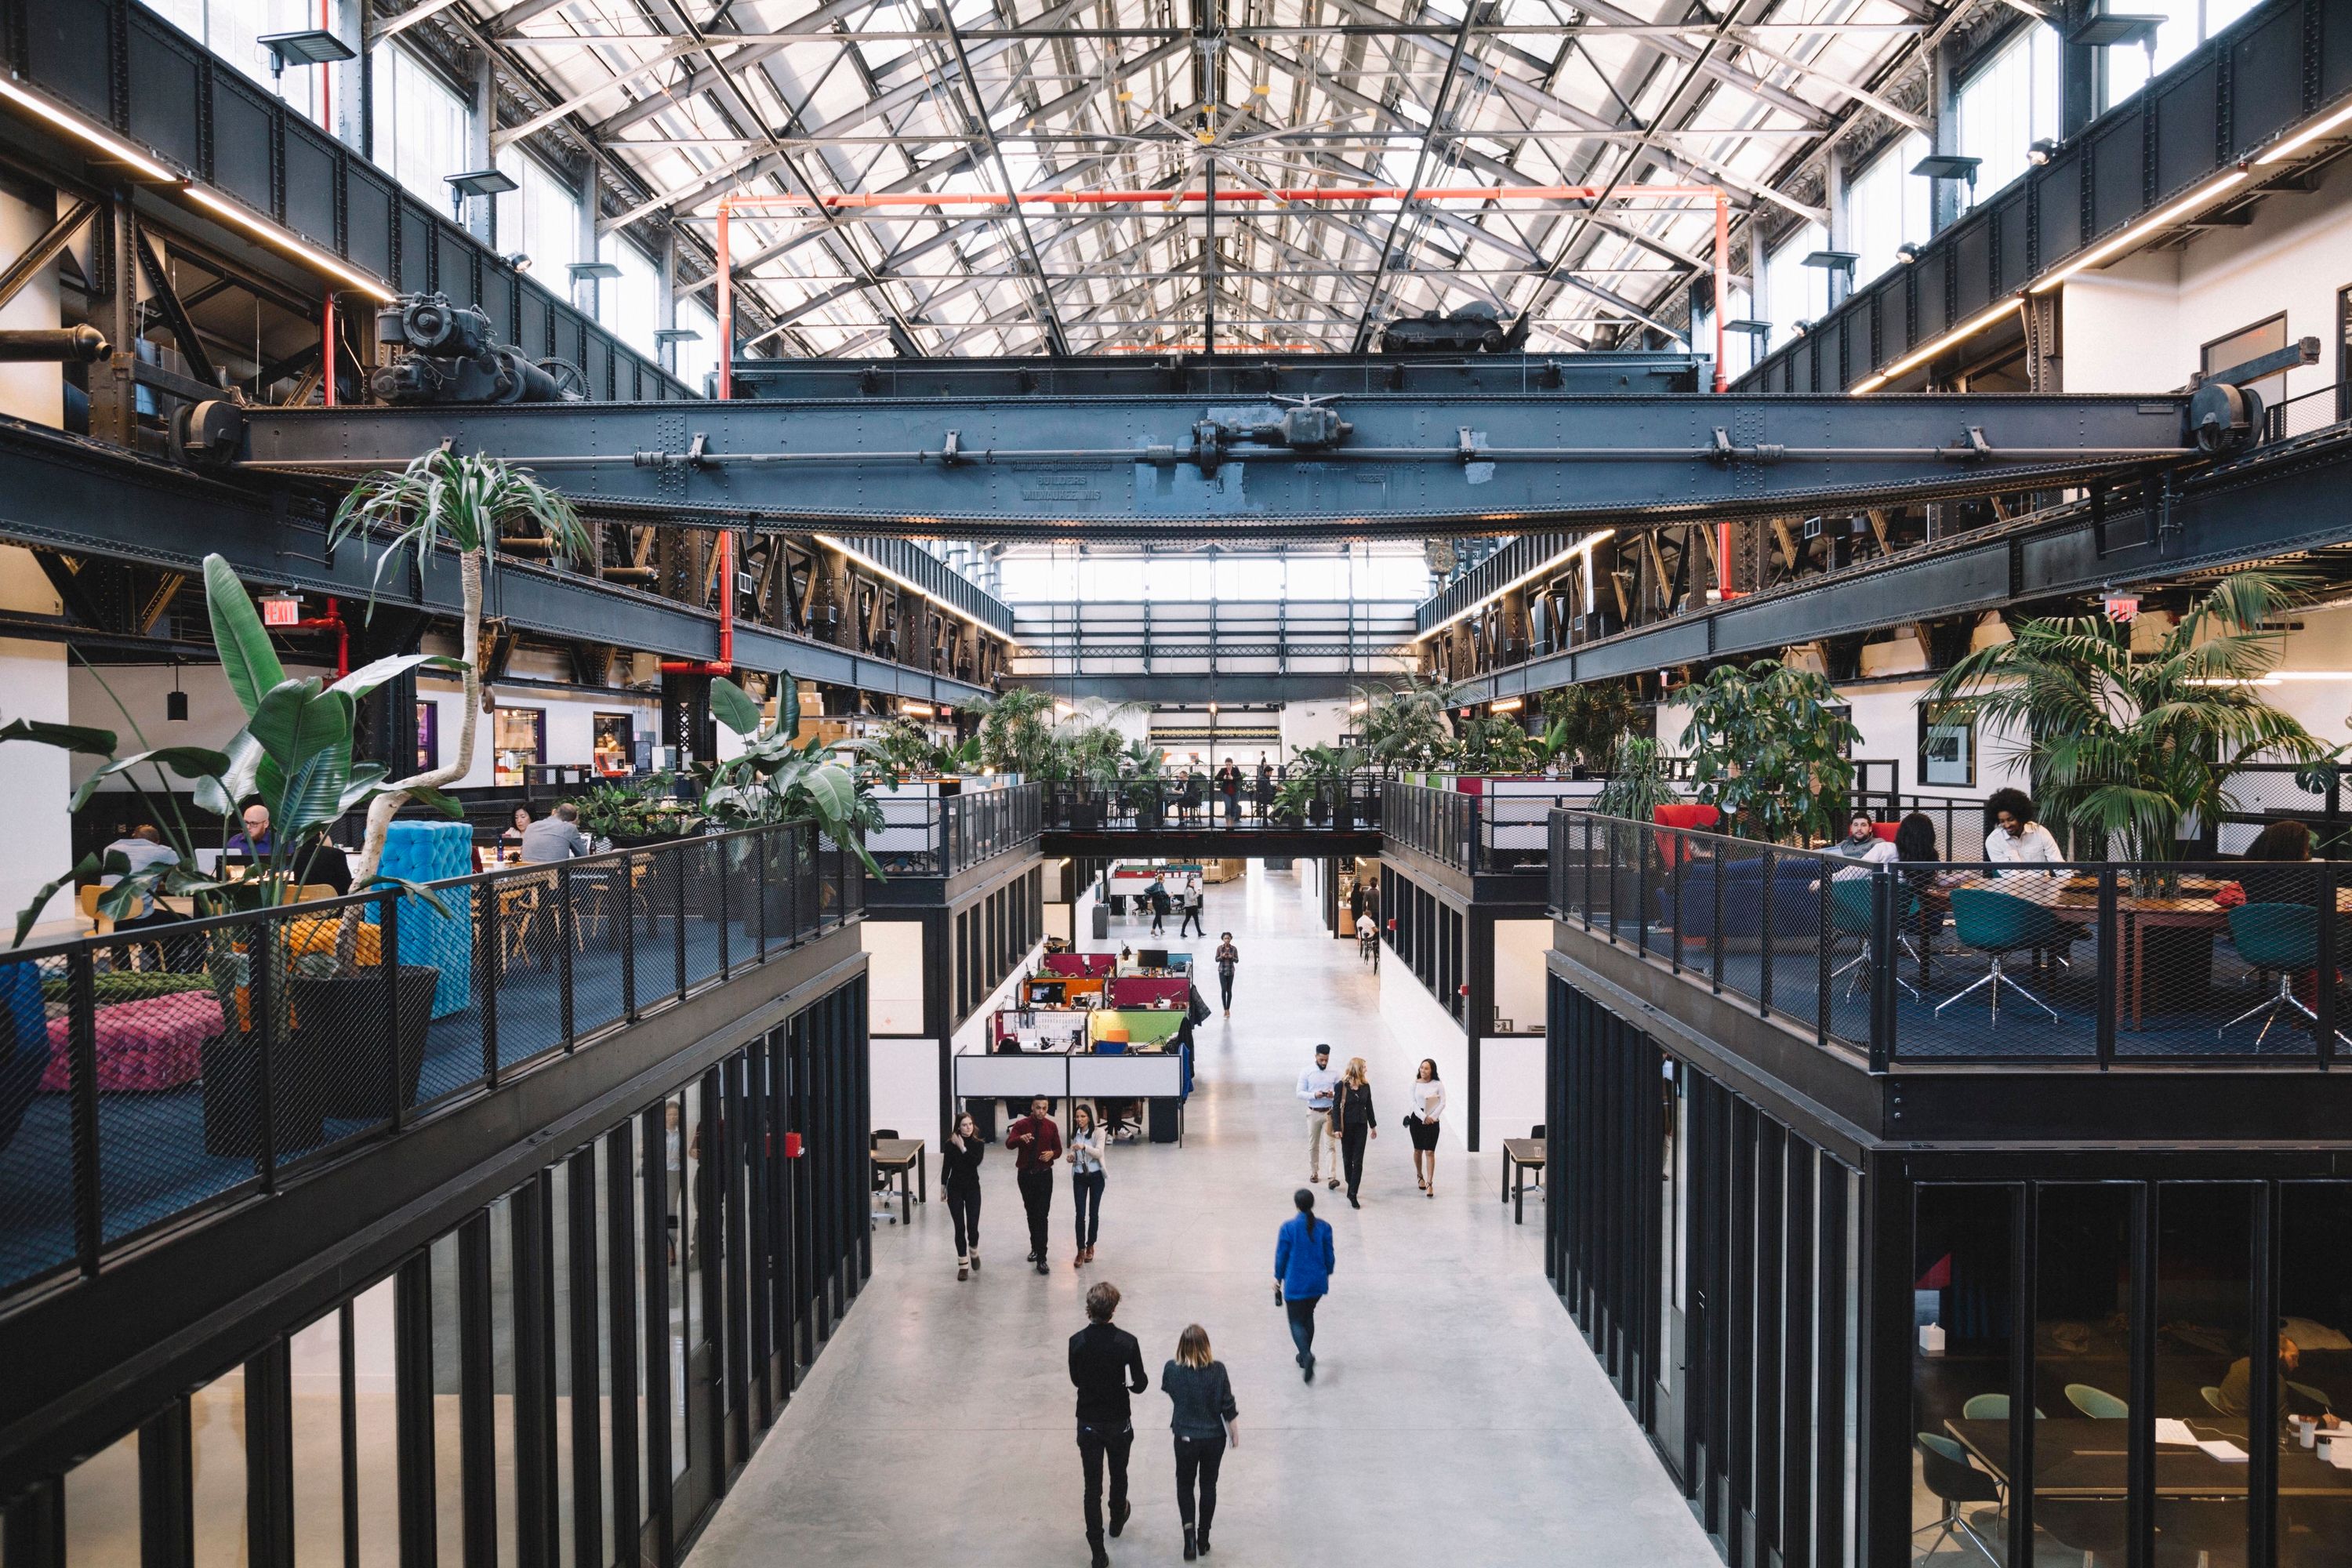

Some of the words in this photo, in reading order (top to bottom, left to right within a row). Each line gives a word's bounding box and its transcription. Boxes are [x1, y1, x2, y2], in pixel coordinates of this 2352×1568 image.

[1037, 475, 1087, 485] BUILDERS
[1022, 490, 1078, 501] MILWAUKEE
[268, 601, 295, 622] EXIT
